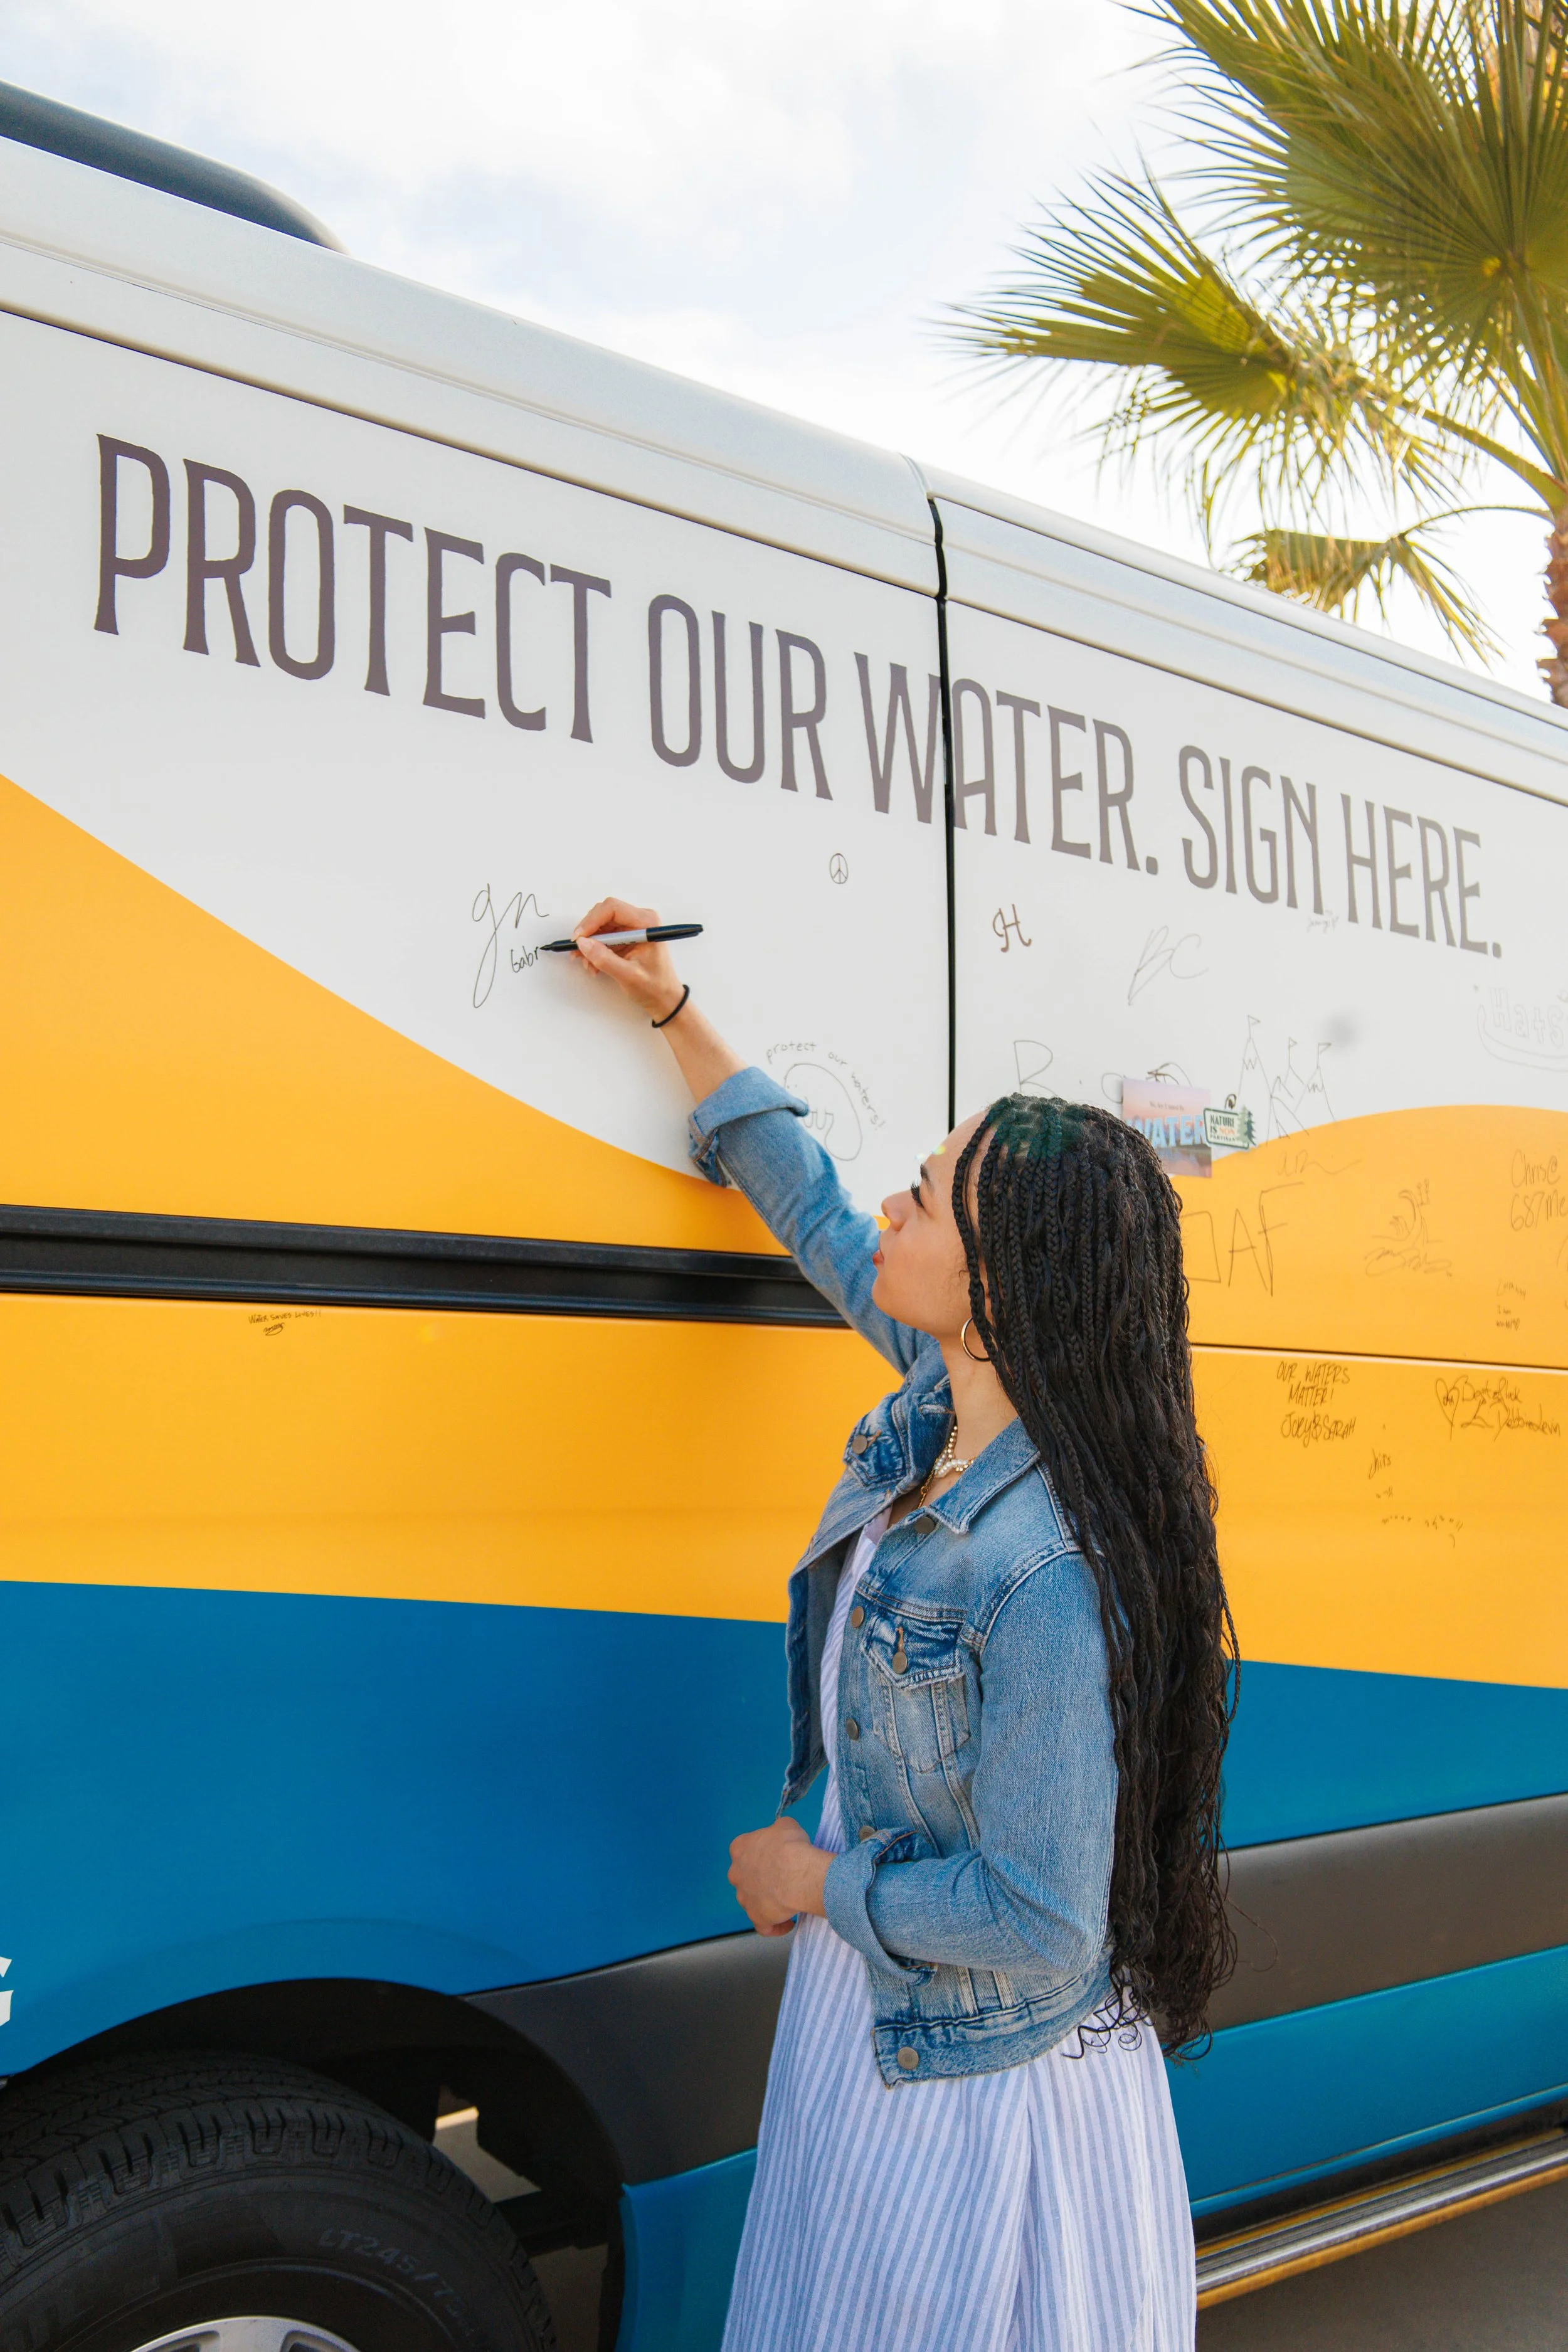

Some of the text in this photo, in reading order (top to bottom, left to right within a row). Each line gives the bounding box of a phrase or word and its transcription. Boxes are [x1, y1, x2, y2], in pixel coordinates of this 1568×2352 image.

[93, 433, 1502, 958] PROTECT OUR WATER. SIGN HERE.
[992, 903, 1032, 953] H
[766, 1041, 817, 1065] protect
[827, 1051, 848, 1066] our
[1210, 1114, 1234, 1128] NATURE
[1276, 1360, 1350, 1387] OUR WATERS
